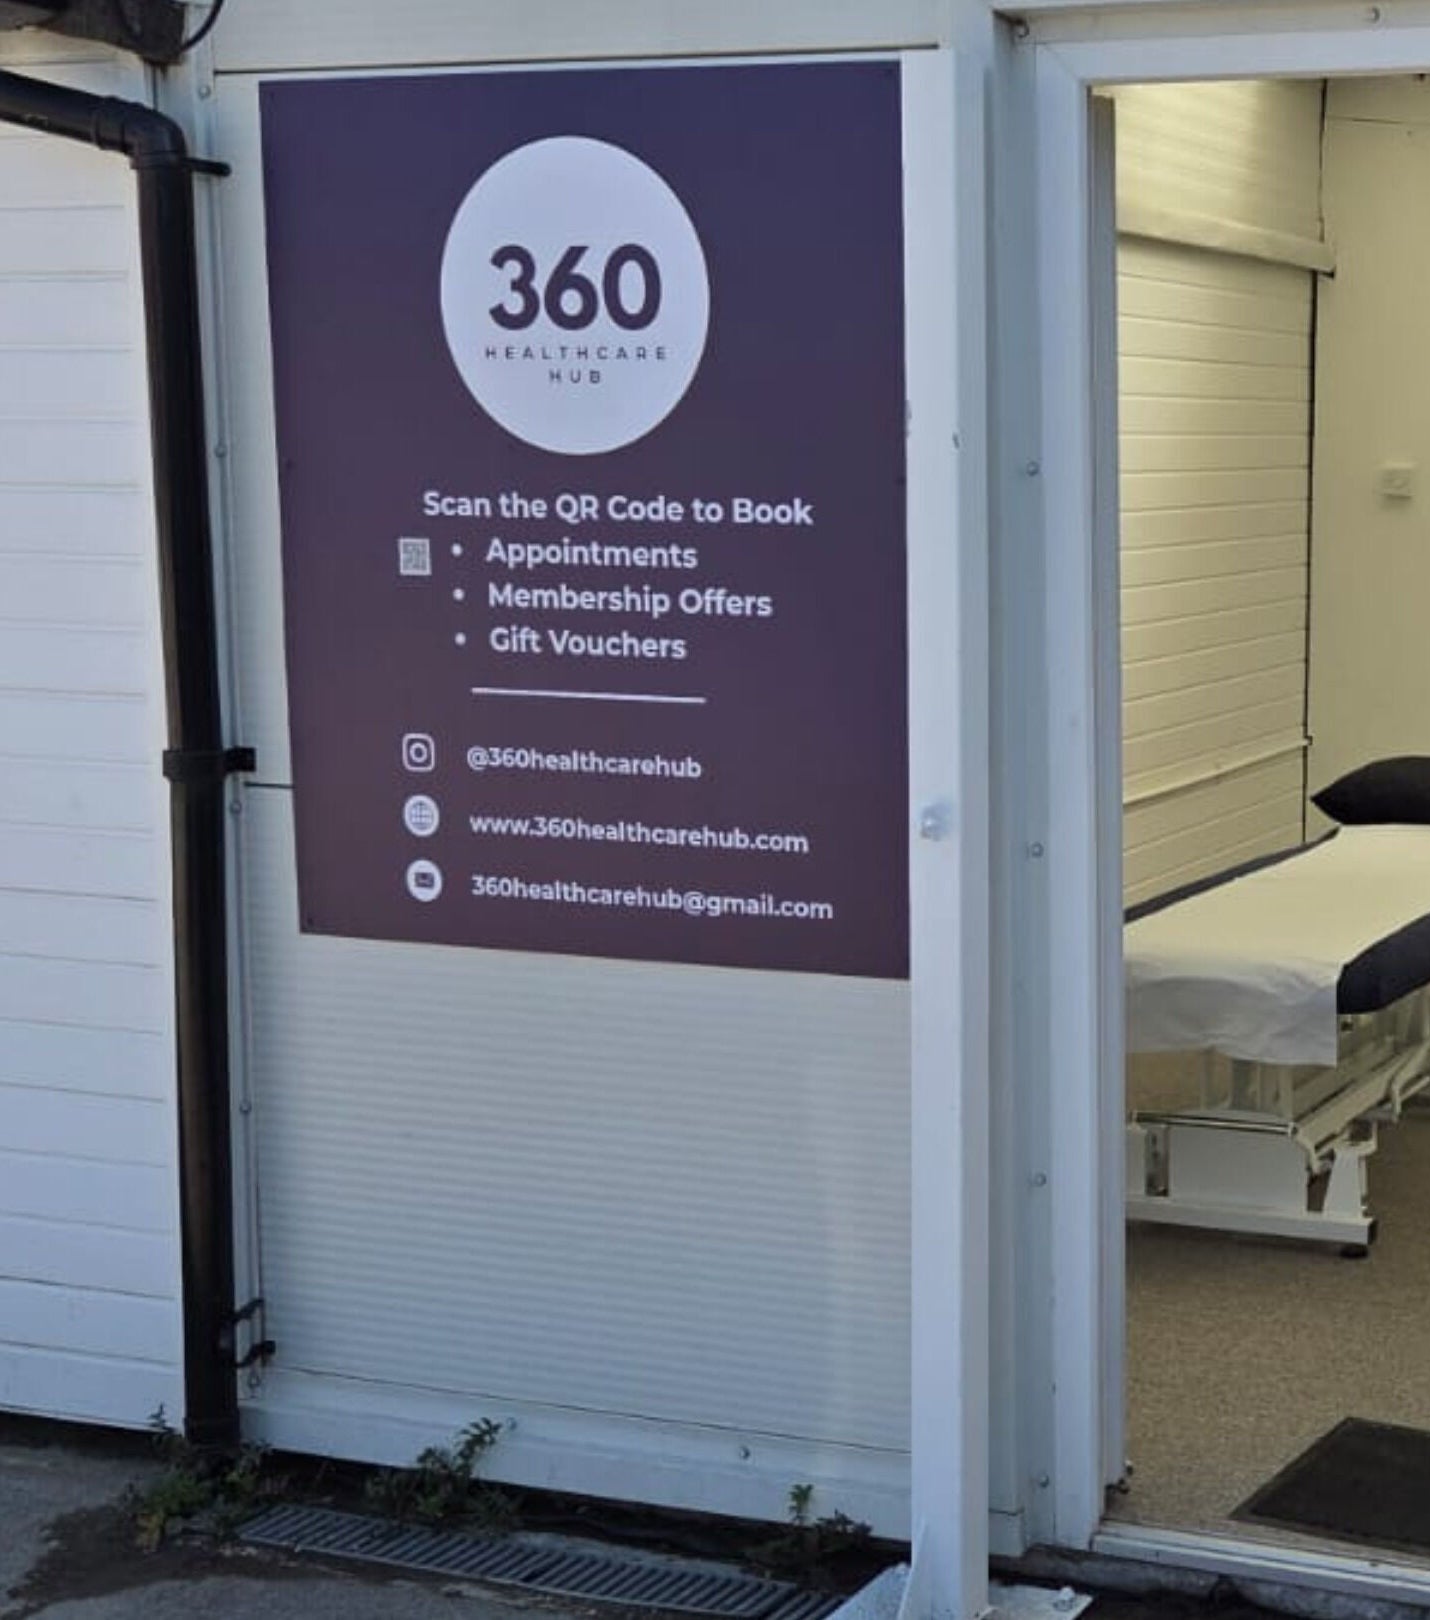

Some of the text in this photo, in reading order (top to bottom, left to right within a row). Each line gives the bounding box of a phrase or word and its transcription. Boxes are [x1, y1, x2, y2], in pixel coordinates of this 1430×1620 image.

[488, 243, 662, 331] 360
[484, 345, 668, 361] HEALTHCARE
[548, 369, 602, 385] HUB
[423, 490, 815, 525] Scan the QR Code to Book
[485, 537, 699, 569] Appointments
[487, 582, 774, 618] Membership Offers
[489, 625, 687, 659] Gift Vouchers
[466, 745, 702, 778] @360healthcarehub
[469, 814, 811, 854] www.360healthcarehub.com
[471, 874, 834, 920] 360healthcarehub@gmail.com
